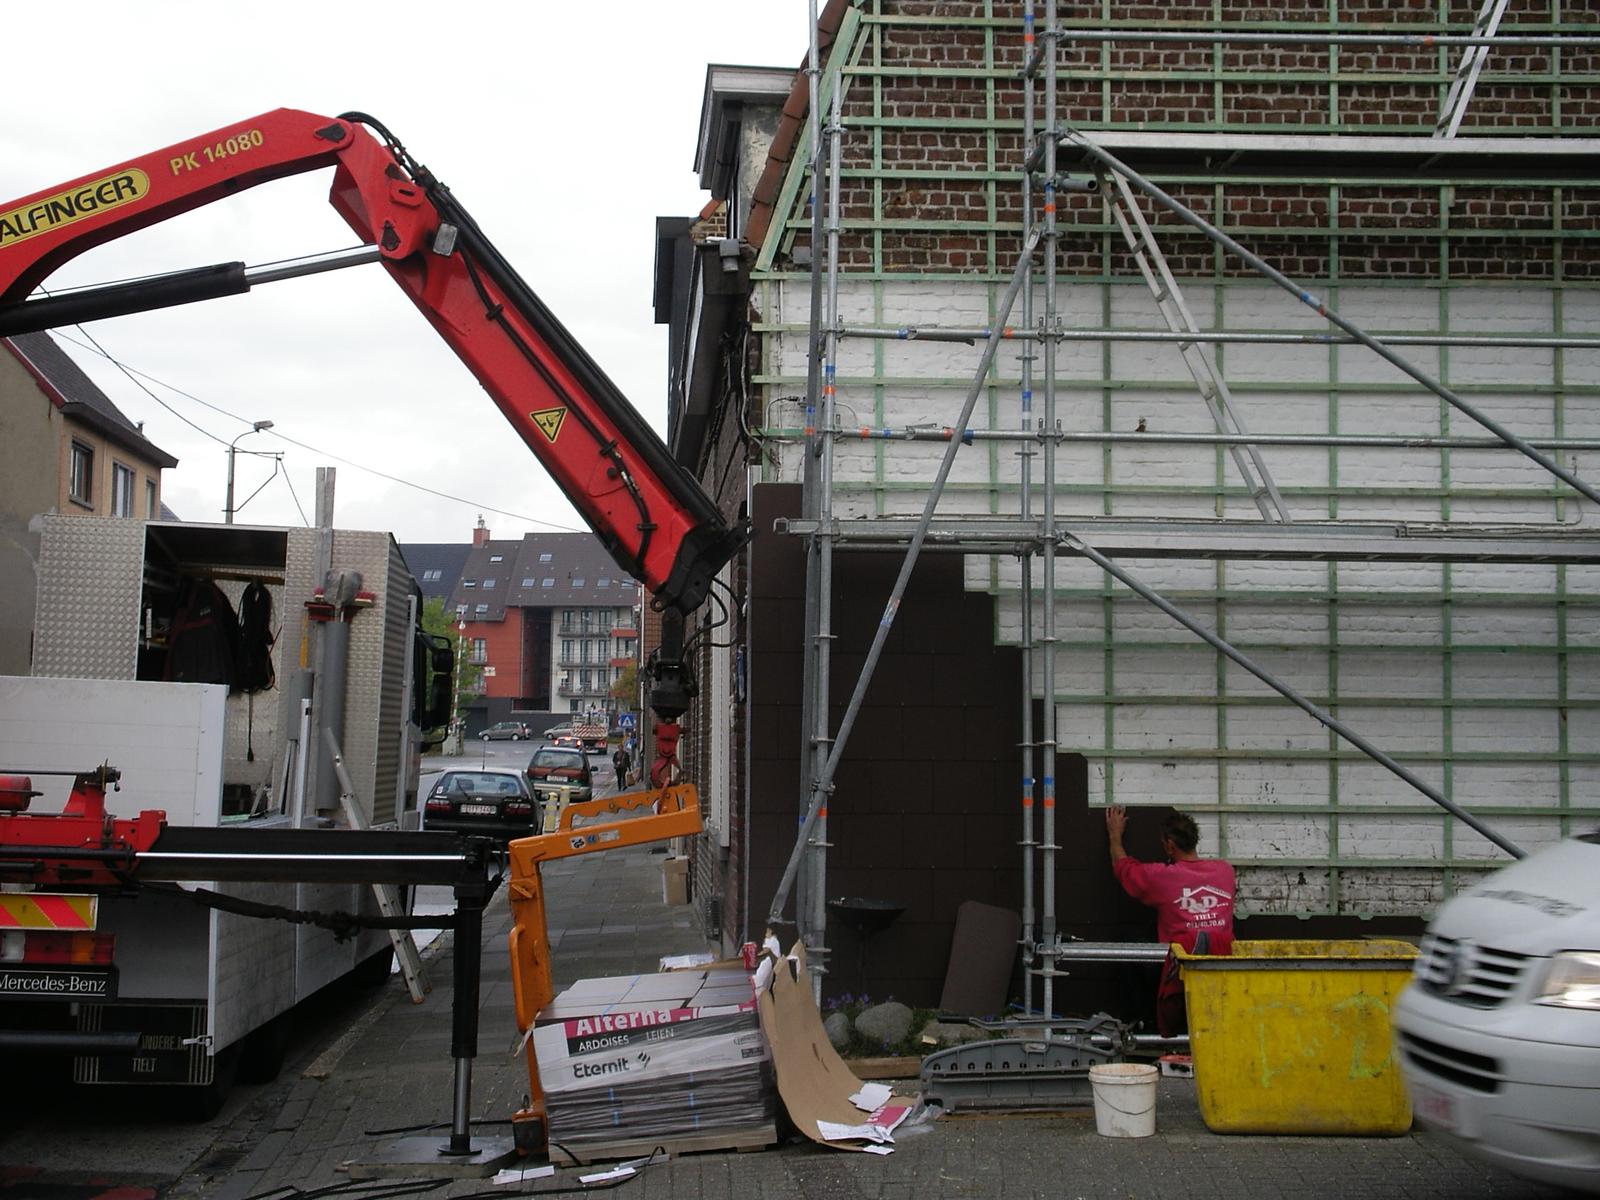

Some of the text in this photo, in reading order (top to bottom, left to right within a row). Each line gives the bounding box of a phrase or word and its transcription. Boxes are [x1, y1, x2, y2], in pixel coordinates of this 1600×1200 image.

[169, 129, 264, 176] PK 14080
[576, 1008, 672, 1036] Alterna
[578, 1027, 675, 1052] ARDOISES LEIEN
[132, 1057, 157, 1073] TIELT
[573, 1057, 630, 1078] Eternit
